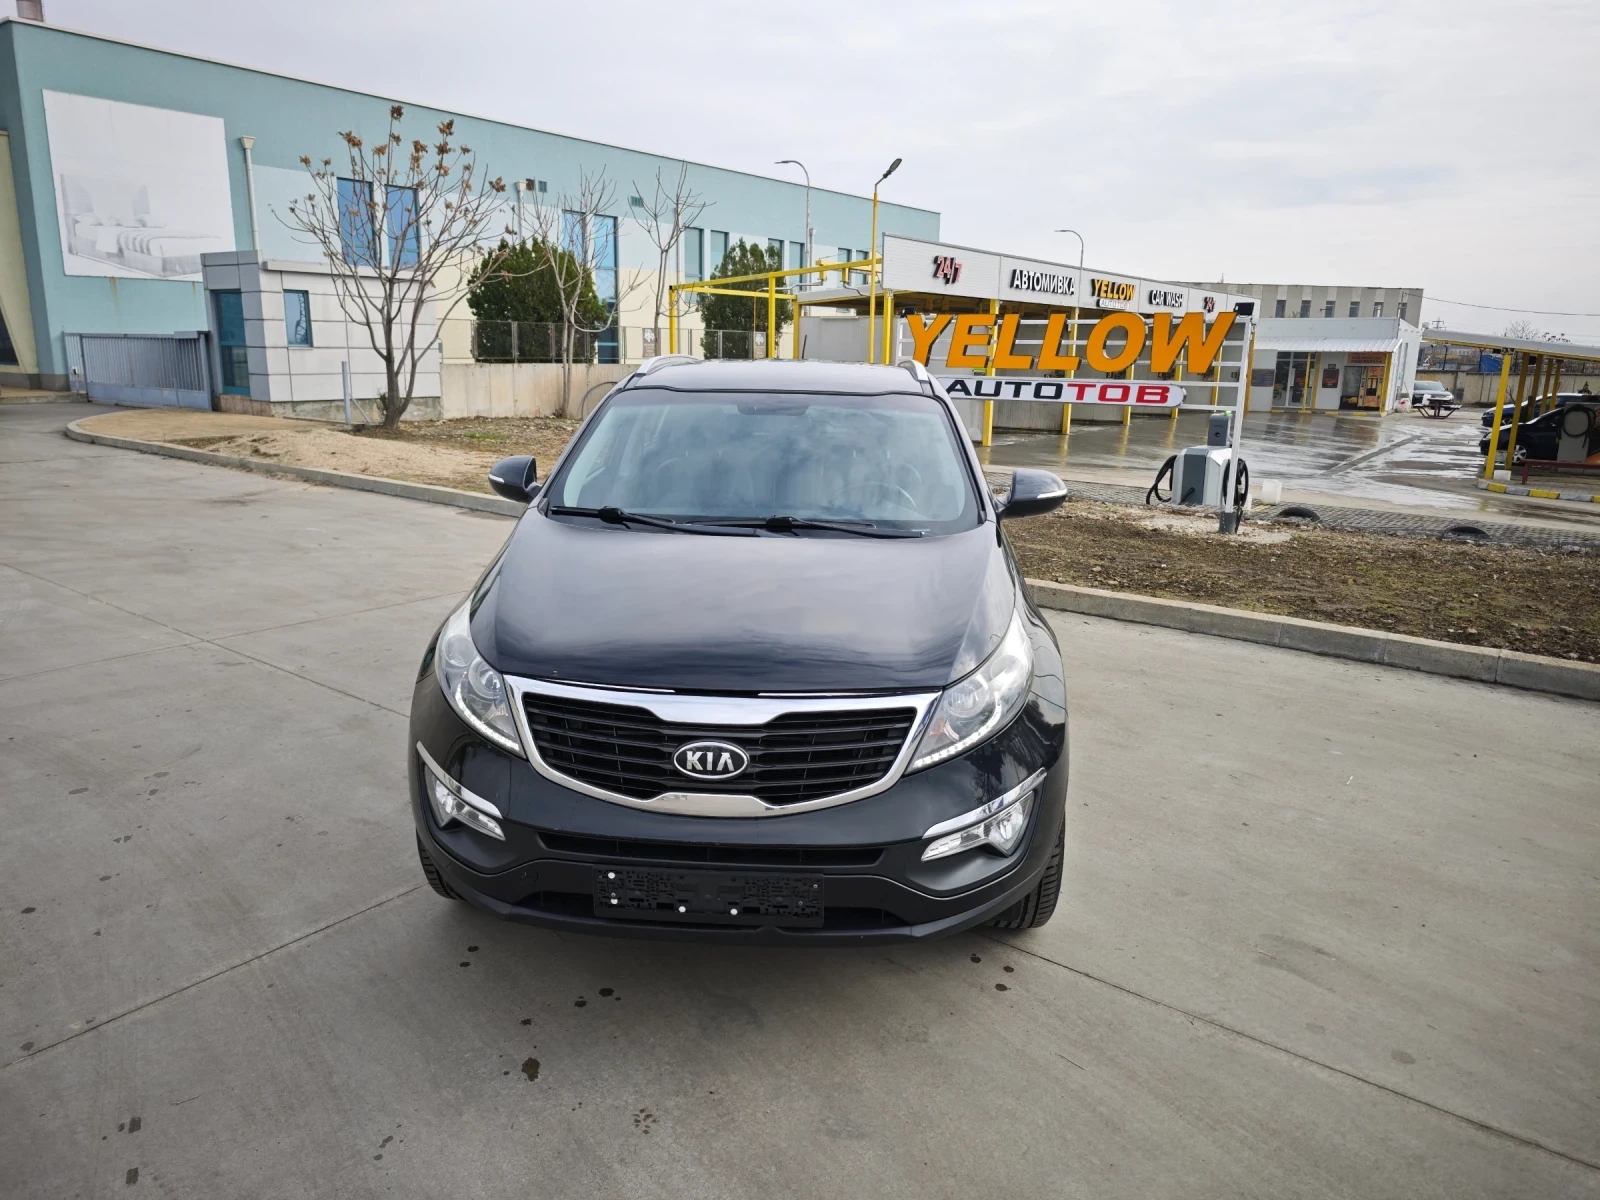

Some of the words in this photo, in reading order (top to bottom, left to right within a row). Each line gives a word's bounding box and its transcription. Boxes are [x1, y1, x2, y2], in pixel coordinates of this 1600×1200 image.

[934, 255, 962, 285] 24/7
[1011, 269, 1075, 295] АВТОМИВКА
[1093, 279, 1136, 300] YELLOW
[1150, 290, 1165, 305] CAR
[1165, 292, 1183, 308] WASH
[907, 312, 1238, 374] YELLOW
[946, 379, 1170, 404] AUTOTOB
[686, 751, 735, 771] KIA
